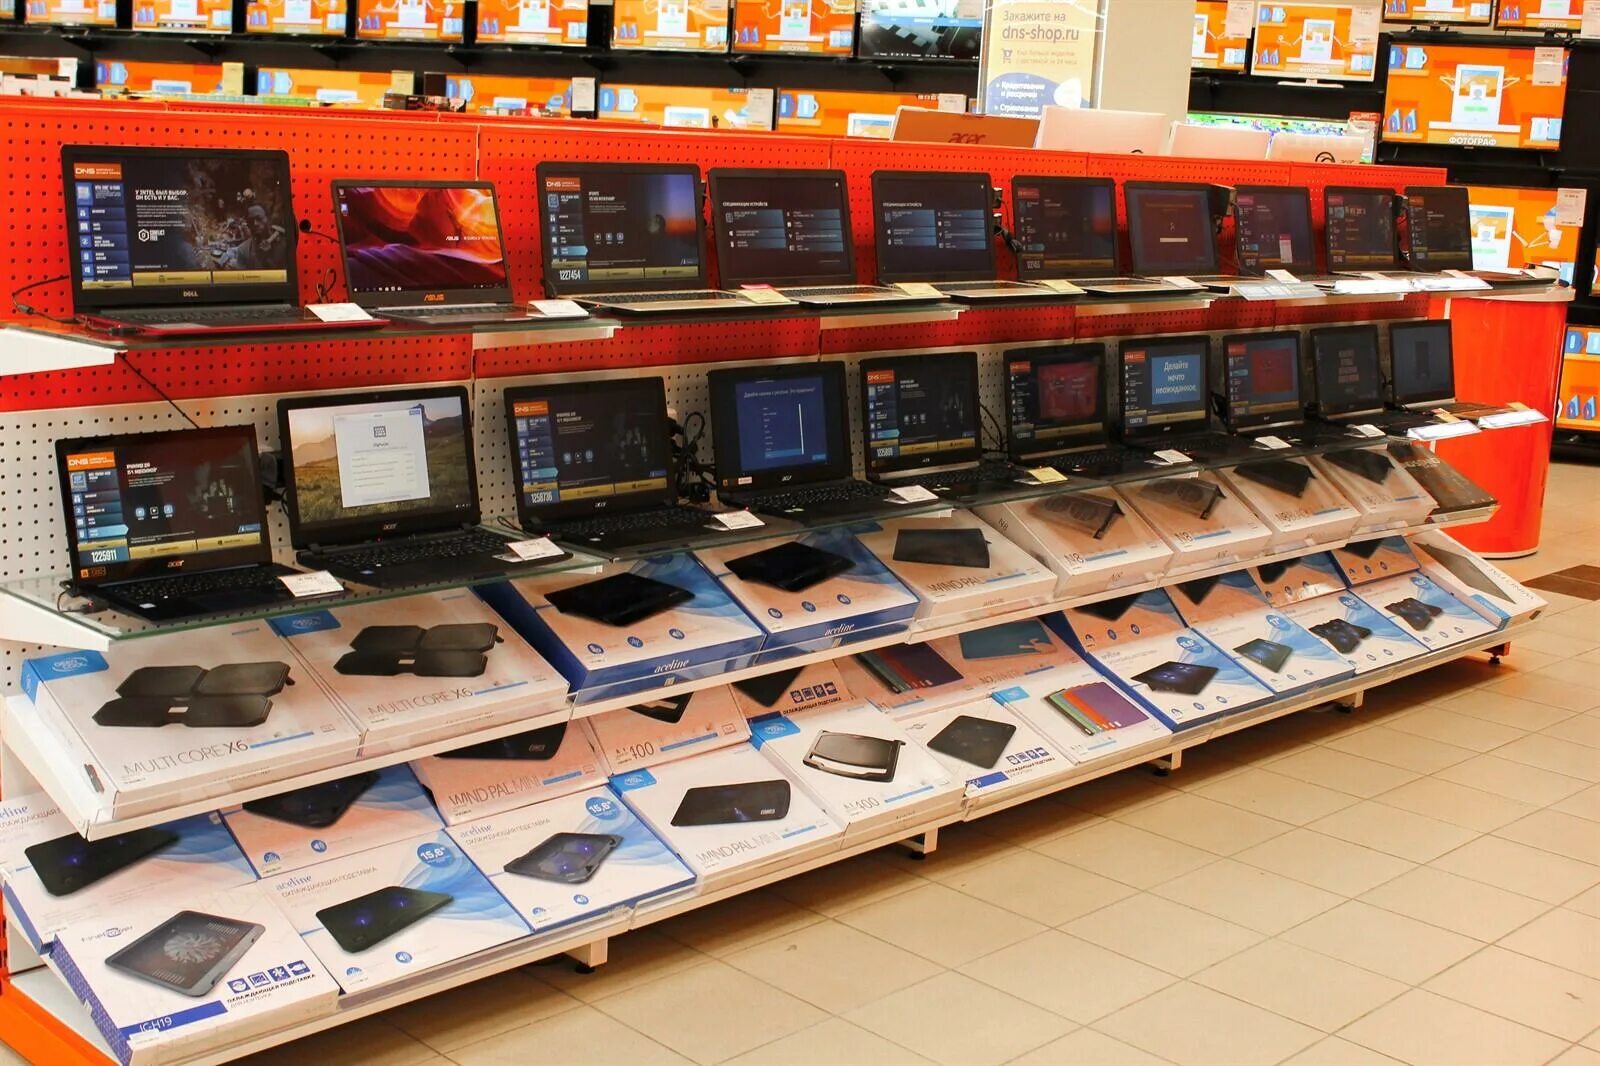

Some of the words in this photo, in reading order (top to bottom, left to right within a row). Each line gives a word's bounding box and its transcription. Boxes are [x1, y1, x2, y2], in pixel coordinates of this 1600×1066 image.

[1003, 10, 1051, 22] Закажите
[1054, 12, 1066, 22] на
[1002, 24, 1080, 44] dns-shop.ru
[948, 132, 986, 144] acer
[1448, 136, 1497, 146] ФОТОГРАФ
[559, 269, 581, 281] 1227454
[424, 293, 445, 302] ASUS
[1164, 361, 1189, 372] Делайте
[1168, 374, 1185, 382] нечто
[68, 458, 89, 466] DNS
[383, 523, 398, 531] acer
[90, 549, 117, 563] 1225911
[168, 559, 185, 568] acer
[823, 622, 856, 637] aceline
[653, 656, 691, 675] aceline
[368, 697, 413, 715] MULTI
[412, 690, 451, 707] CORE
[450, 687, 474, 700] X6
[782, 701, 819, 715] ОХЛАЖДАЮЩАЯ
[123, 754, 177, 775] MULTI
[176, 743, 224, 764] CORE
[223, 738, 249, 755] X6
[448, 786, 489, 805] WIND
[487, 782, 515, 800] PAL
[512, 774, 543, 793] MINI
[459, 823, 493, 839] aceline
[696, 845, 735, 863] WIND
[732, 838, 759, 855] PAL
[276, 874, 313, 892] aceline
[227, 984, 280, 1004] ОХЛАЖДАЮЩАЯ
[279, 973, 317, 988] ПОДСТАВКА
